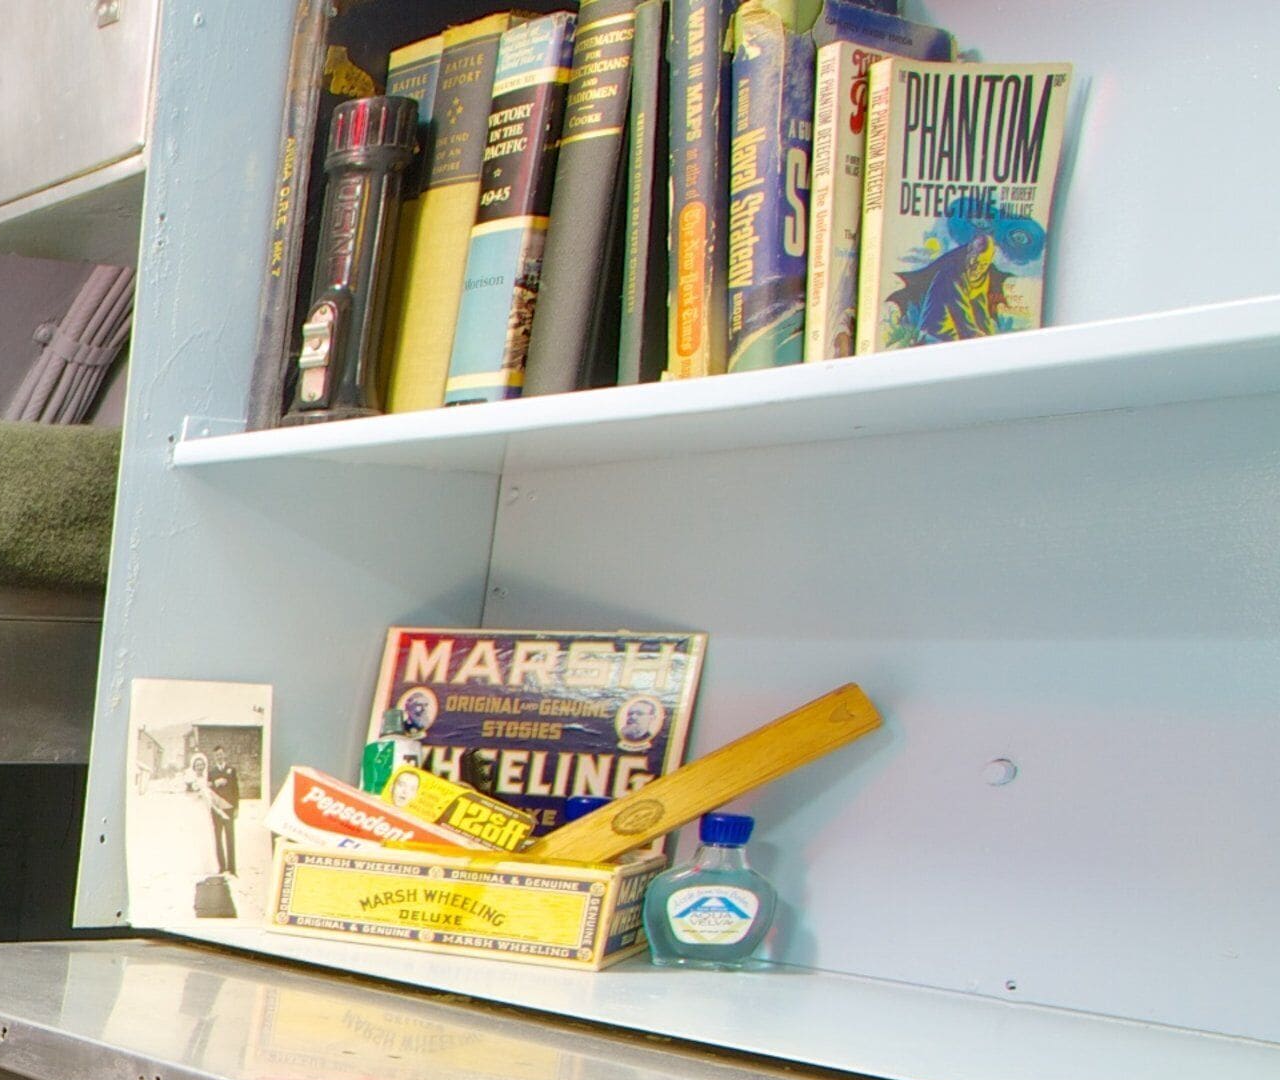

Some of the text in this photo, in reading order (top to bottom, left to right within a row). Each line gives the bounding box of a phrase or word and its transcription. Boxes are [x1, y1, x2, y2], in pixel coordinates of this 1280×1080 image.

[576, 27, 635, 54] ATHEMATICS
[687, 6, 705, 60] WAR
[445, 53, 485, 73] BATTLE
[570, 55, 631, 82] LECTRICIANS
[687, 62, 703, 79] IN
[442, 70, 482, 91] REPORT
[488, 102, 535, 128] VICTORY
[685, 82, 703, 142] MAPS
[817, 78, 834, 125] PHANTOM
[490, 123, 525, 143] IN THE
[634, 112, 646, 170] ENGINEERS
[901, 70, 1055, 184] PHANTOM
[483, 137, 528, 162] PACIFIC
[814, 126, 832, 178] DETECTIVE
[481, 185, 512, 206] 1945
[632, 173, 642, 204] RADIO
[899, 181, 997, 218] DETECTIVE
[1011, 186, 1038, 201] ROBERT
[631, 205, 641, 226] FOR
[728, 126, 767, 289] Naval Strategy
[629, 229, 640, 254] DATA
[402, 638, 679, 689] MARSH
[444, 695, 522, 715] ORIGINAL
[538, 697, 615, 718] GENUINE
[480, 719, 564, 740] STOGIES
[301, 785, 415, 842] Pepsodent
[480, 818, 531, 852] off
[279, 864, 294, 913] ORIGINAL
[303, 854, 349, 869] MARSH
[351, 859, 422, 877] WHEELING
[449, 869, 507, 884] ORIGINAL
[523, 876, 580, 891] GENUINE
[359, 887, 507, 928] MARSH WHEELING
[398, 908, 464, 927] DELUXE
[582, 897, 600, 946] GENUINE
[295, 917, 349, 932] ORIGINAL
[361, 925, 414, 940] GENUINE
[440, 934, 492, 950] MARSH
[496, 939, 571, 959] WHEELING
